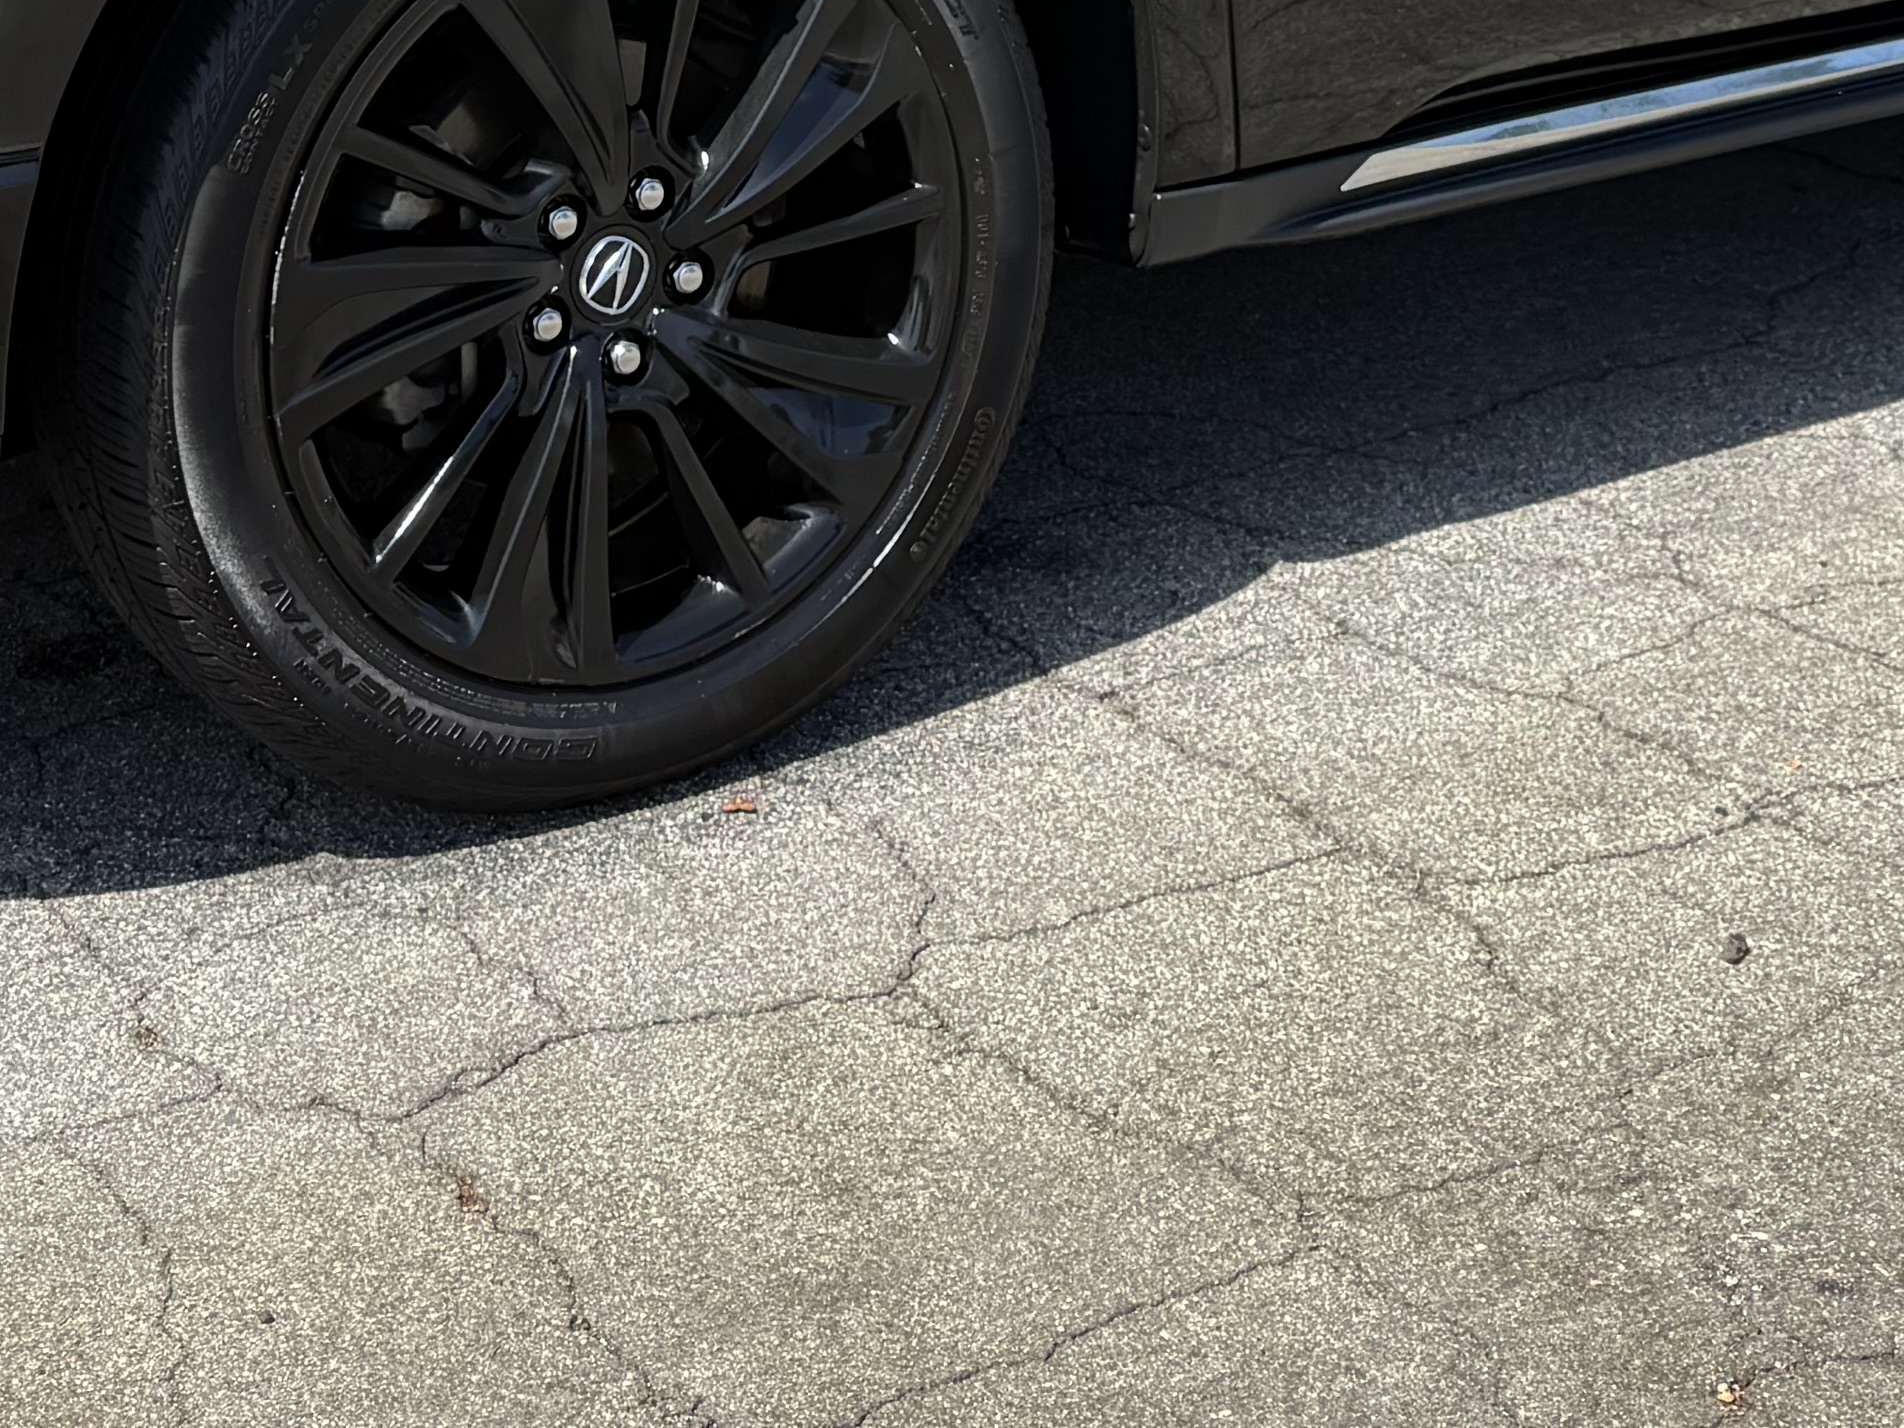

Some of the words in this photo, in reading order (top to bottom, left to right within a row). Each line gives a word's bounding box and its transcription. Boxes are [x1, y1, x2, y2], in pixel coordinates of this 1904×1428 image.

[227, 91, 271, 172] CROSS
[268, 33, 313, 90] LX
[260, 555, 601, 762] CONTINENTAL
